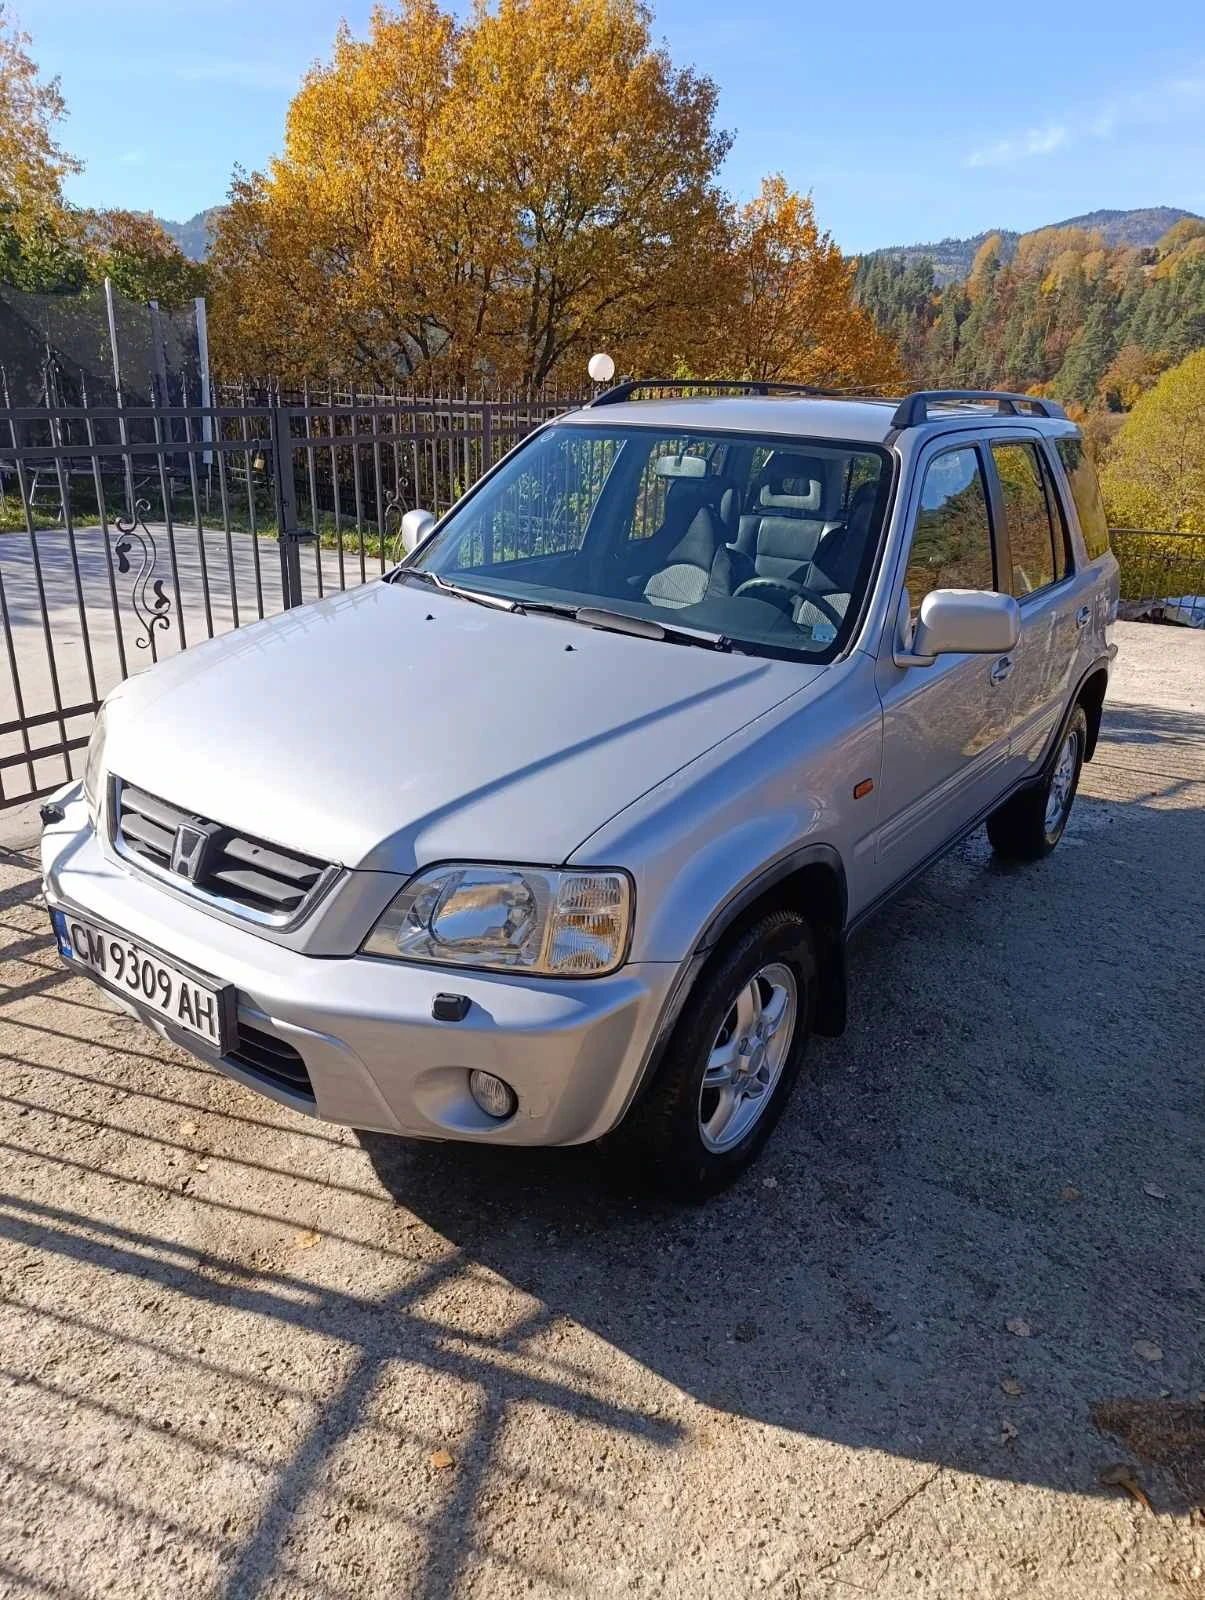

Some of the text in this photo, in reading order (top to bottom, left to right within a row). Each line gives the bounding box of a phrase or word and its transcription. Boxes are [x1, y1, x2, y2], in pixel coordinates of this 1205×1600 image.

[71, 923, 215, 1038] CM 9309 AH
